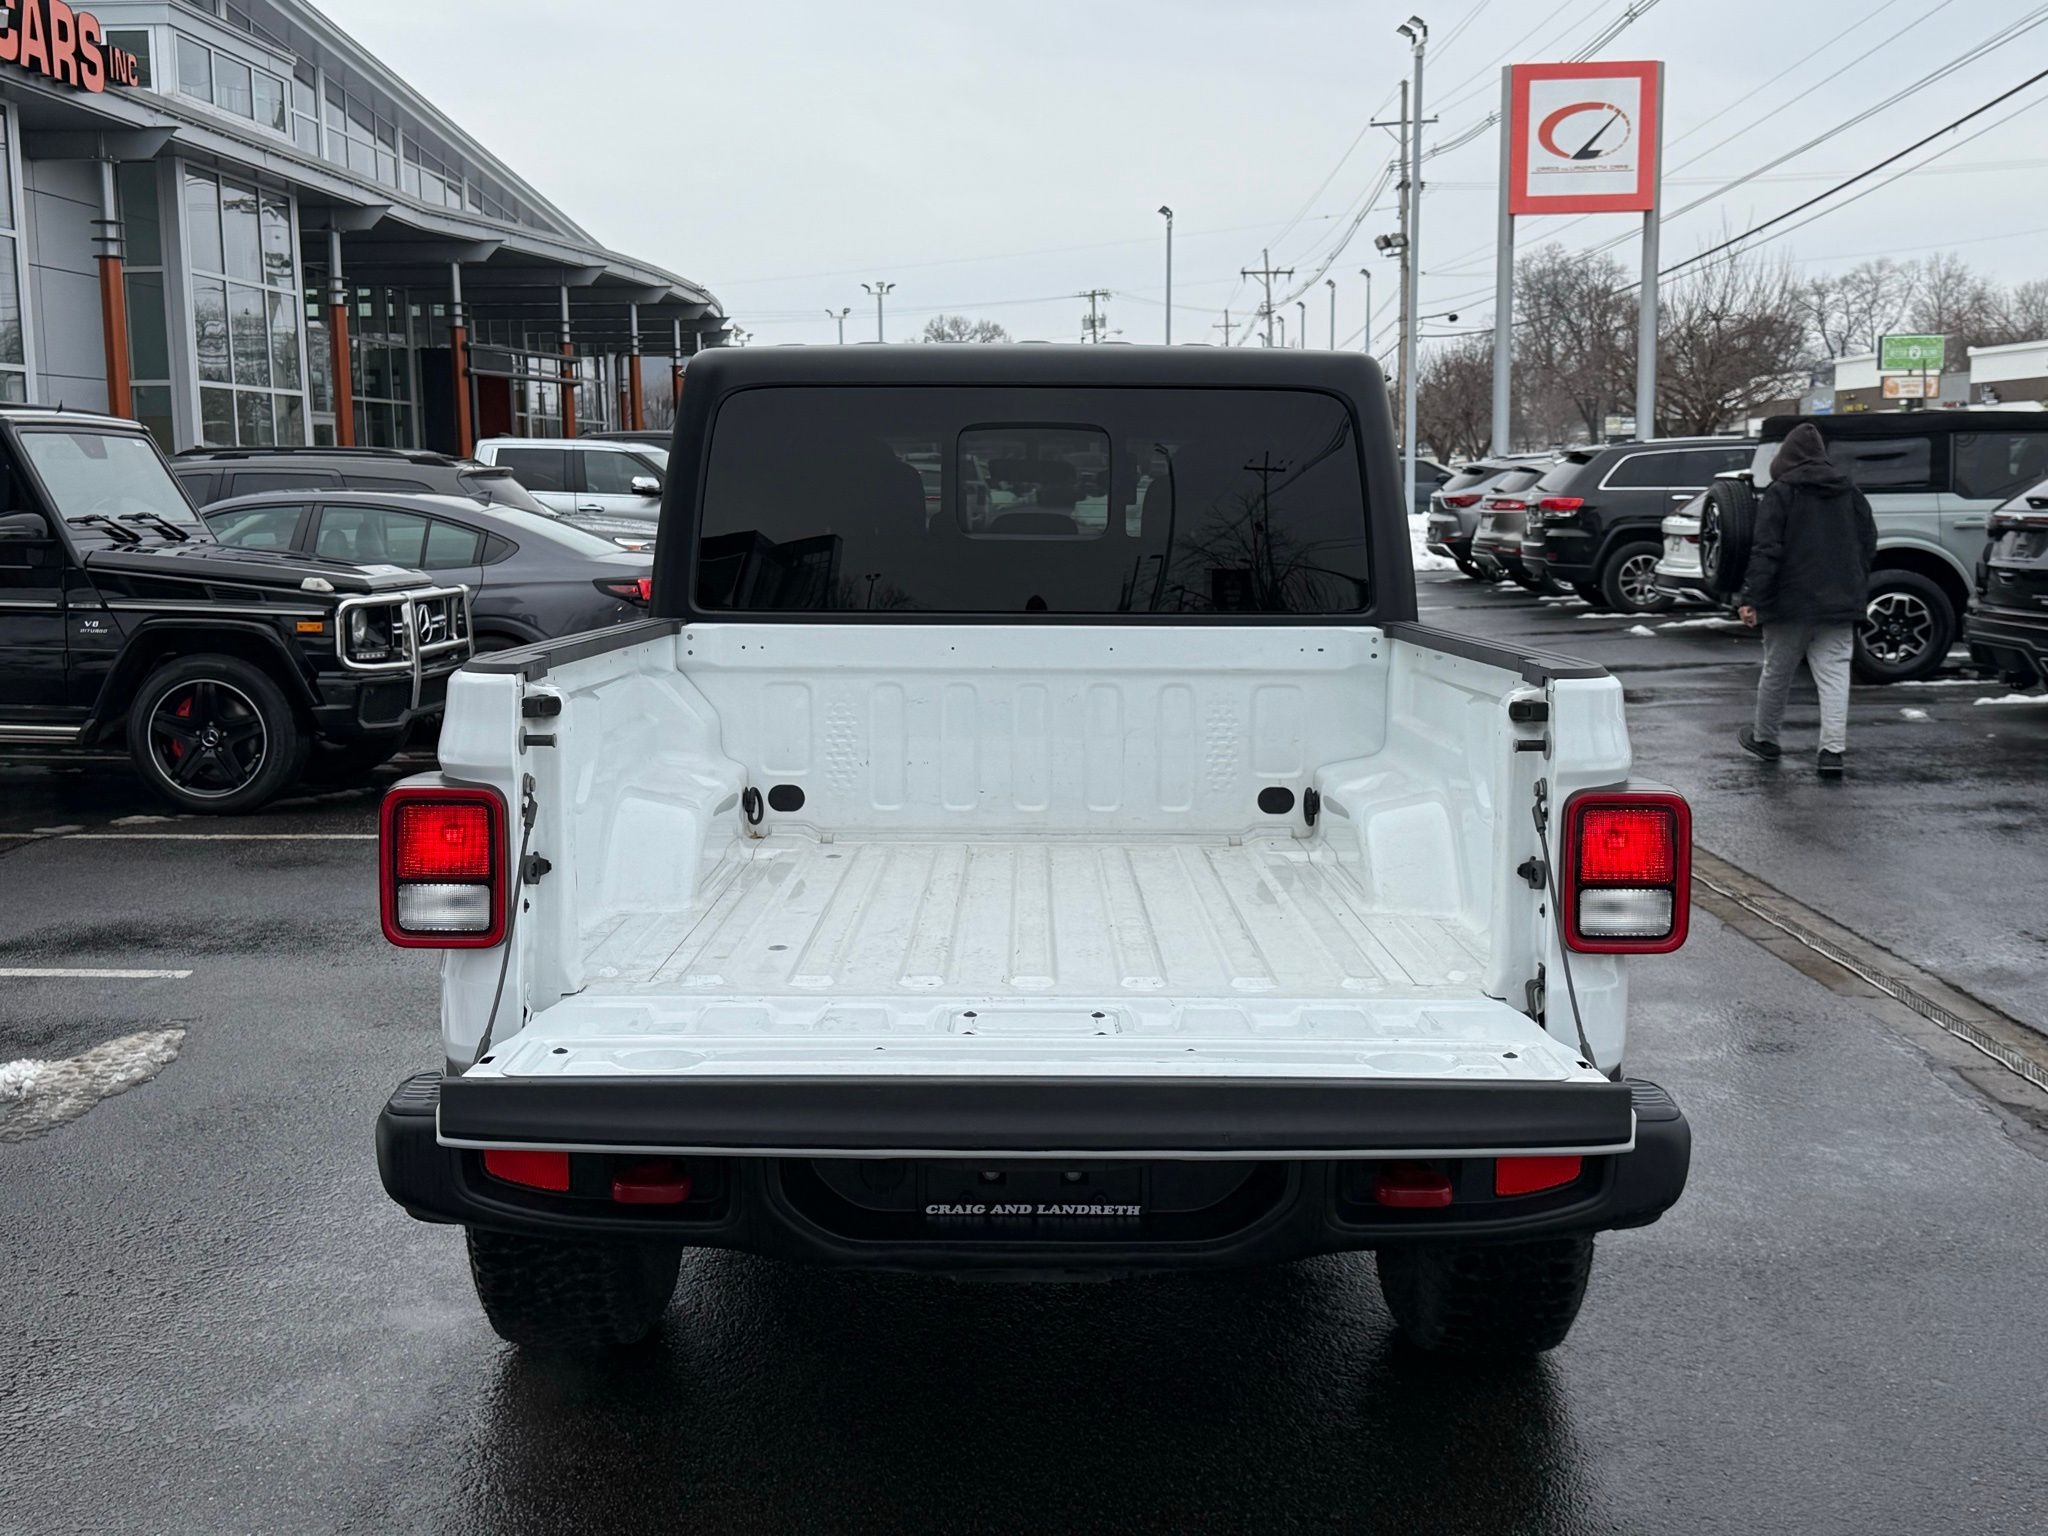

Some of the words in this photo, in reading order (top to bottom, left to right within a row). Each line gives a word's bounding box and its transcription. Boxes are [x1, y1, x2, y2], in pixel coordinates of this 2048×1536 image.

[109, 45, 139, 87] INC
[925, 1204, 986, 1215] CRAIG
[989, 1204, 1033, 1215] AND
[1036, 1204, 1142, 1216] LANDRETH
